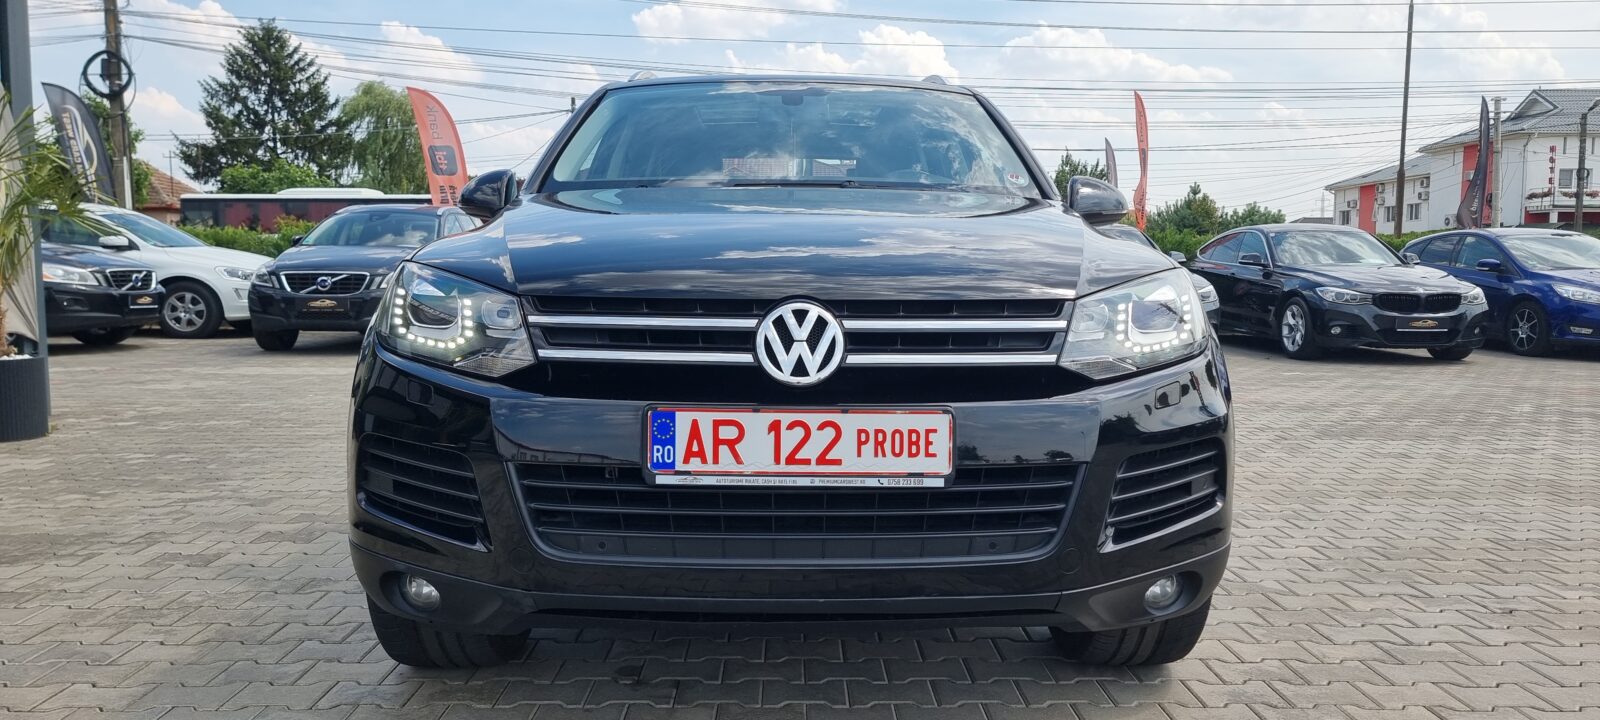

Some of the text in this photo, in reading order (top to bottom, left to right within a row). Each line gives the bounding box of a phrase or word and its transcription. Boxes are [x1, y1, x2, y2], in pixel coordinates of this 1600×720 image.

[653, 445, 674, 463] RO
[682, 418, 938, 466] AR 122 PROBE
